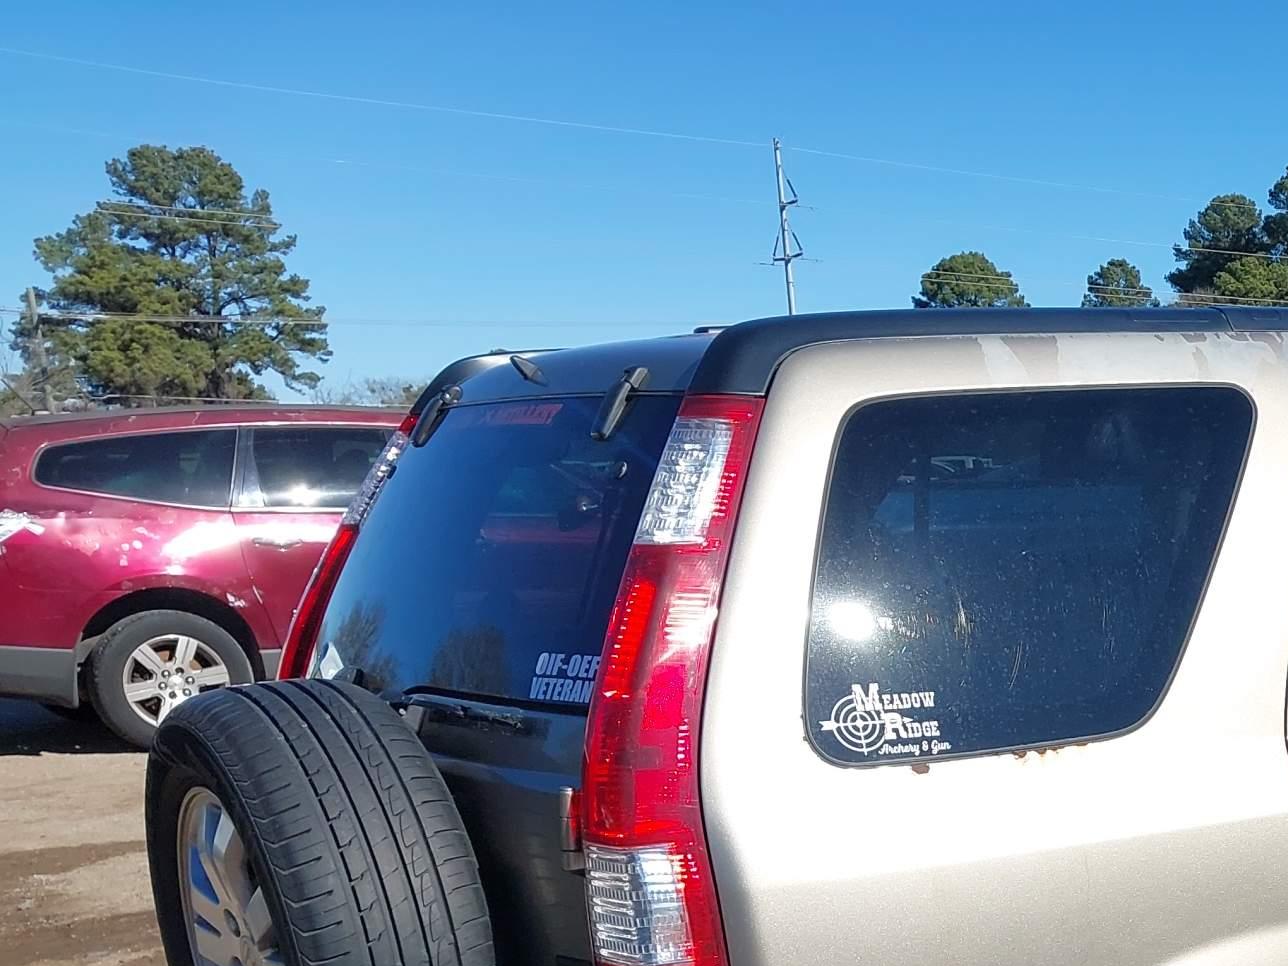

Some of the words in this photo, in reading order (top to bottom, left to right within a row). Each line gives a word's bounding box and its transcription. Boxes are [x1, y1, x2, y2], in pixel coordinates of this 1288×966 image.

[536, 652, 601, 678] OIF-OEF
[530, 677, 594, 703] VETERAN
[878, 742, 920, 757] Archery
[922, 741, 929, 751] &
[931, 740, 952, 755] Gun
